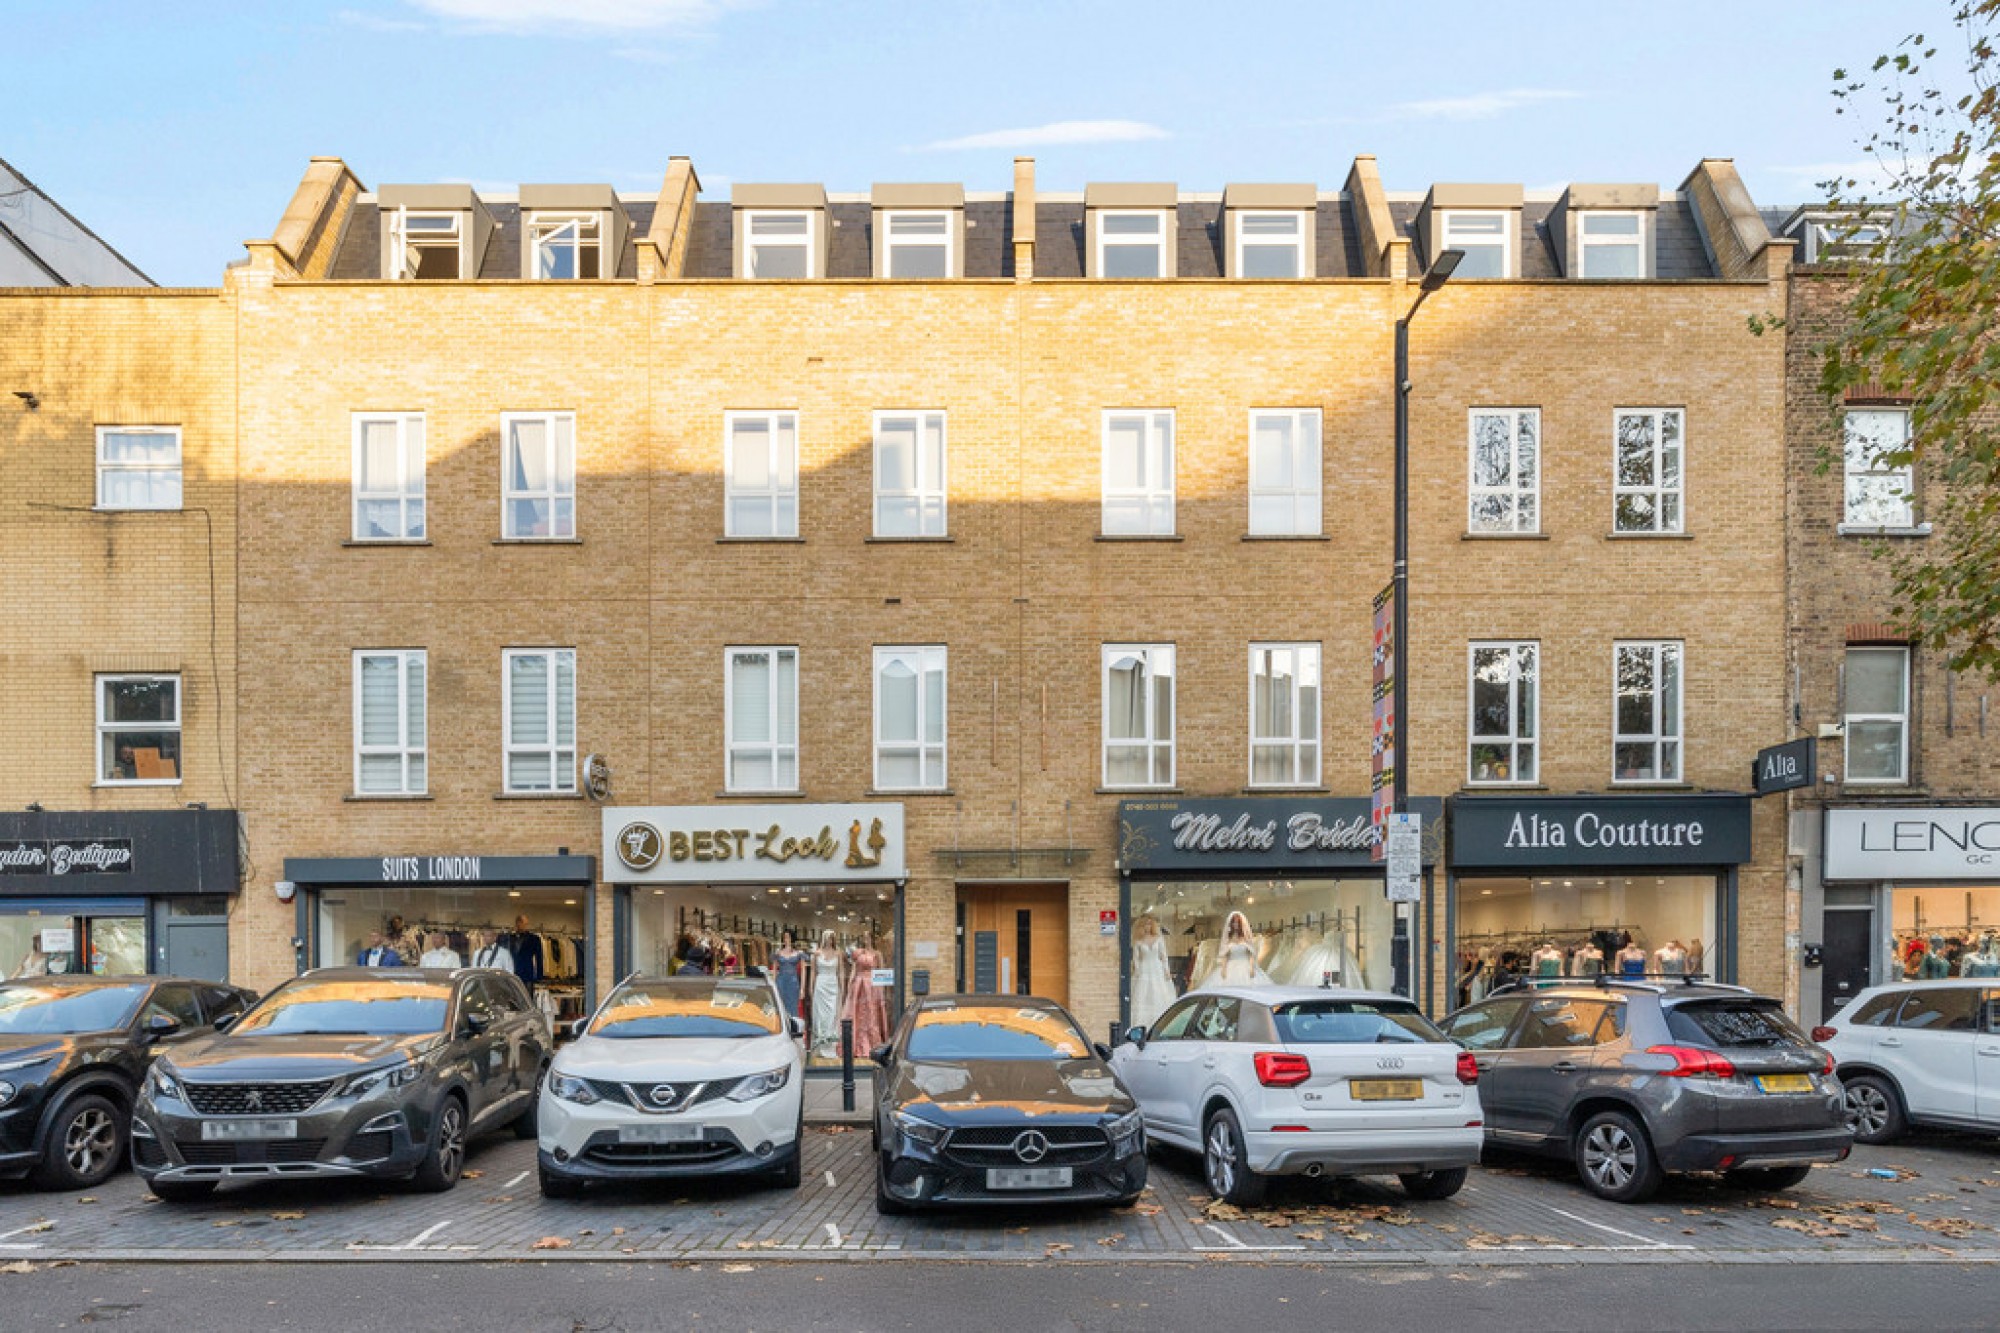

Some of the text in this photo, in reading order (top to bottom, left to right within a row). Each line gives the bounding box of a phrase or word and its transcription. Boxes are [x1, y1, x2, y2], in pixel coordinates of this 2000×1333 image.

[1763, 754, 1797, 780] Alia
[669, 829, 750, 862] BEST
[755, 823, 840, 863] Look
[1170, 811, 1277, 851] Mehri
[1286, 812, 1372, 851] Brida
[1504, 811, 1704, 848] Alia Couture
[51, 843, 130, 875] Boutique
[382, 856, 480, 881] SUITS LONDON
[1966, 854, 1993, 865] GC
